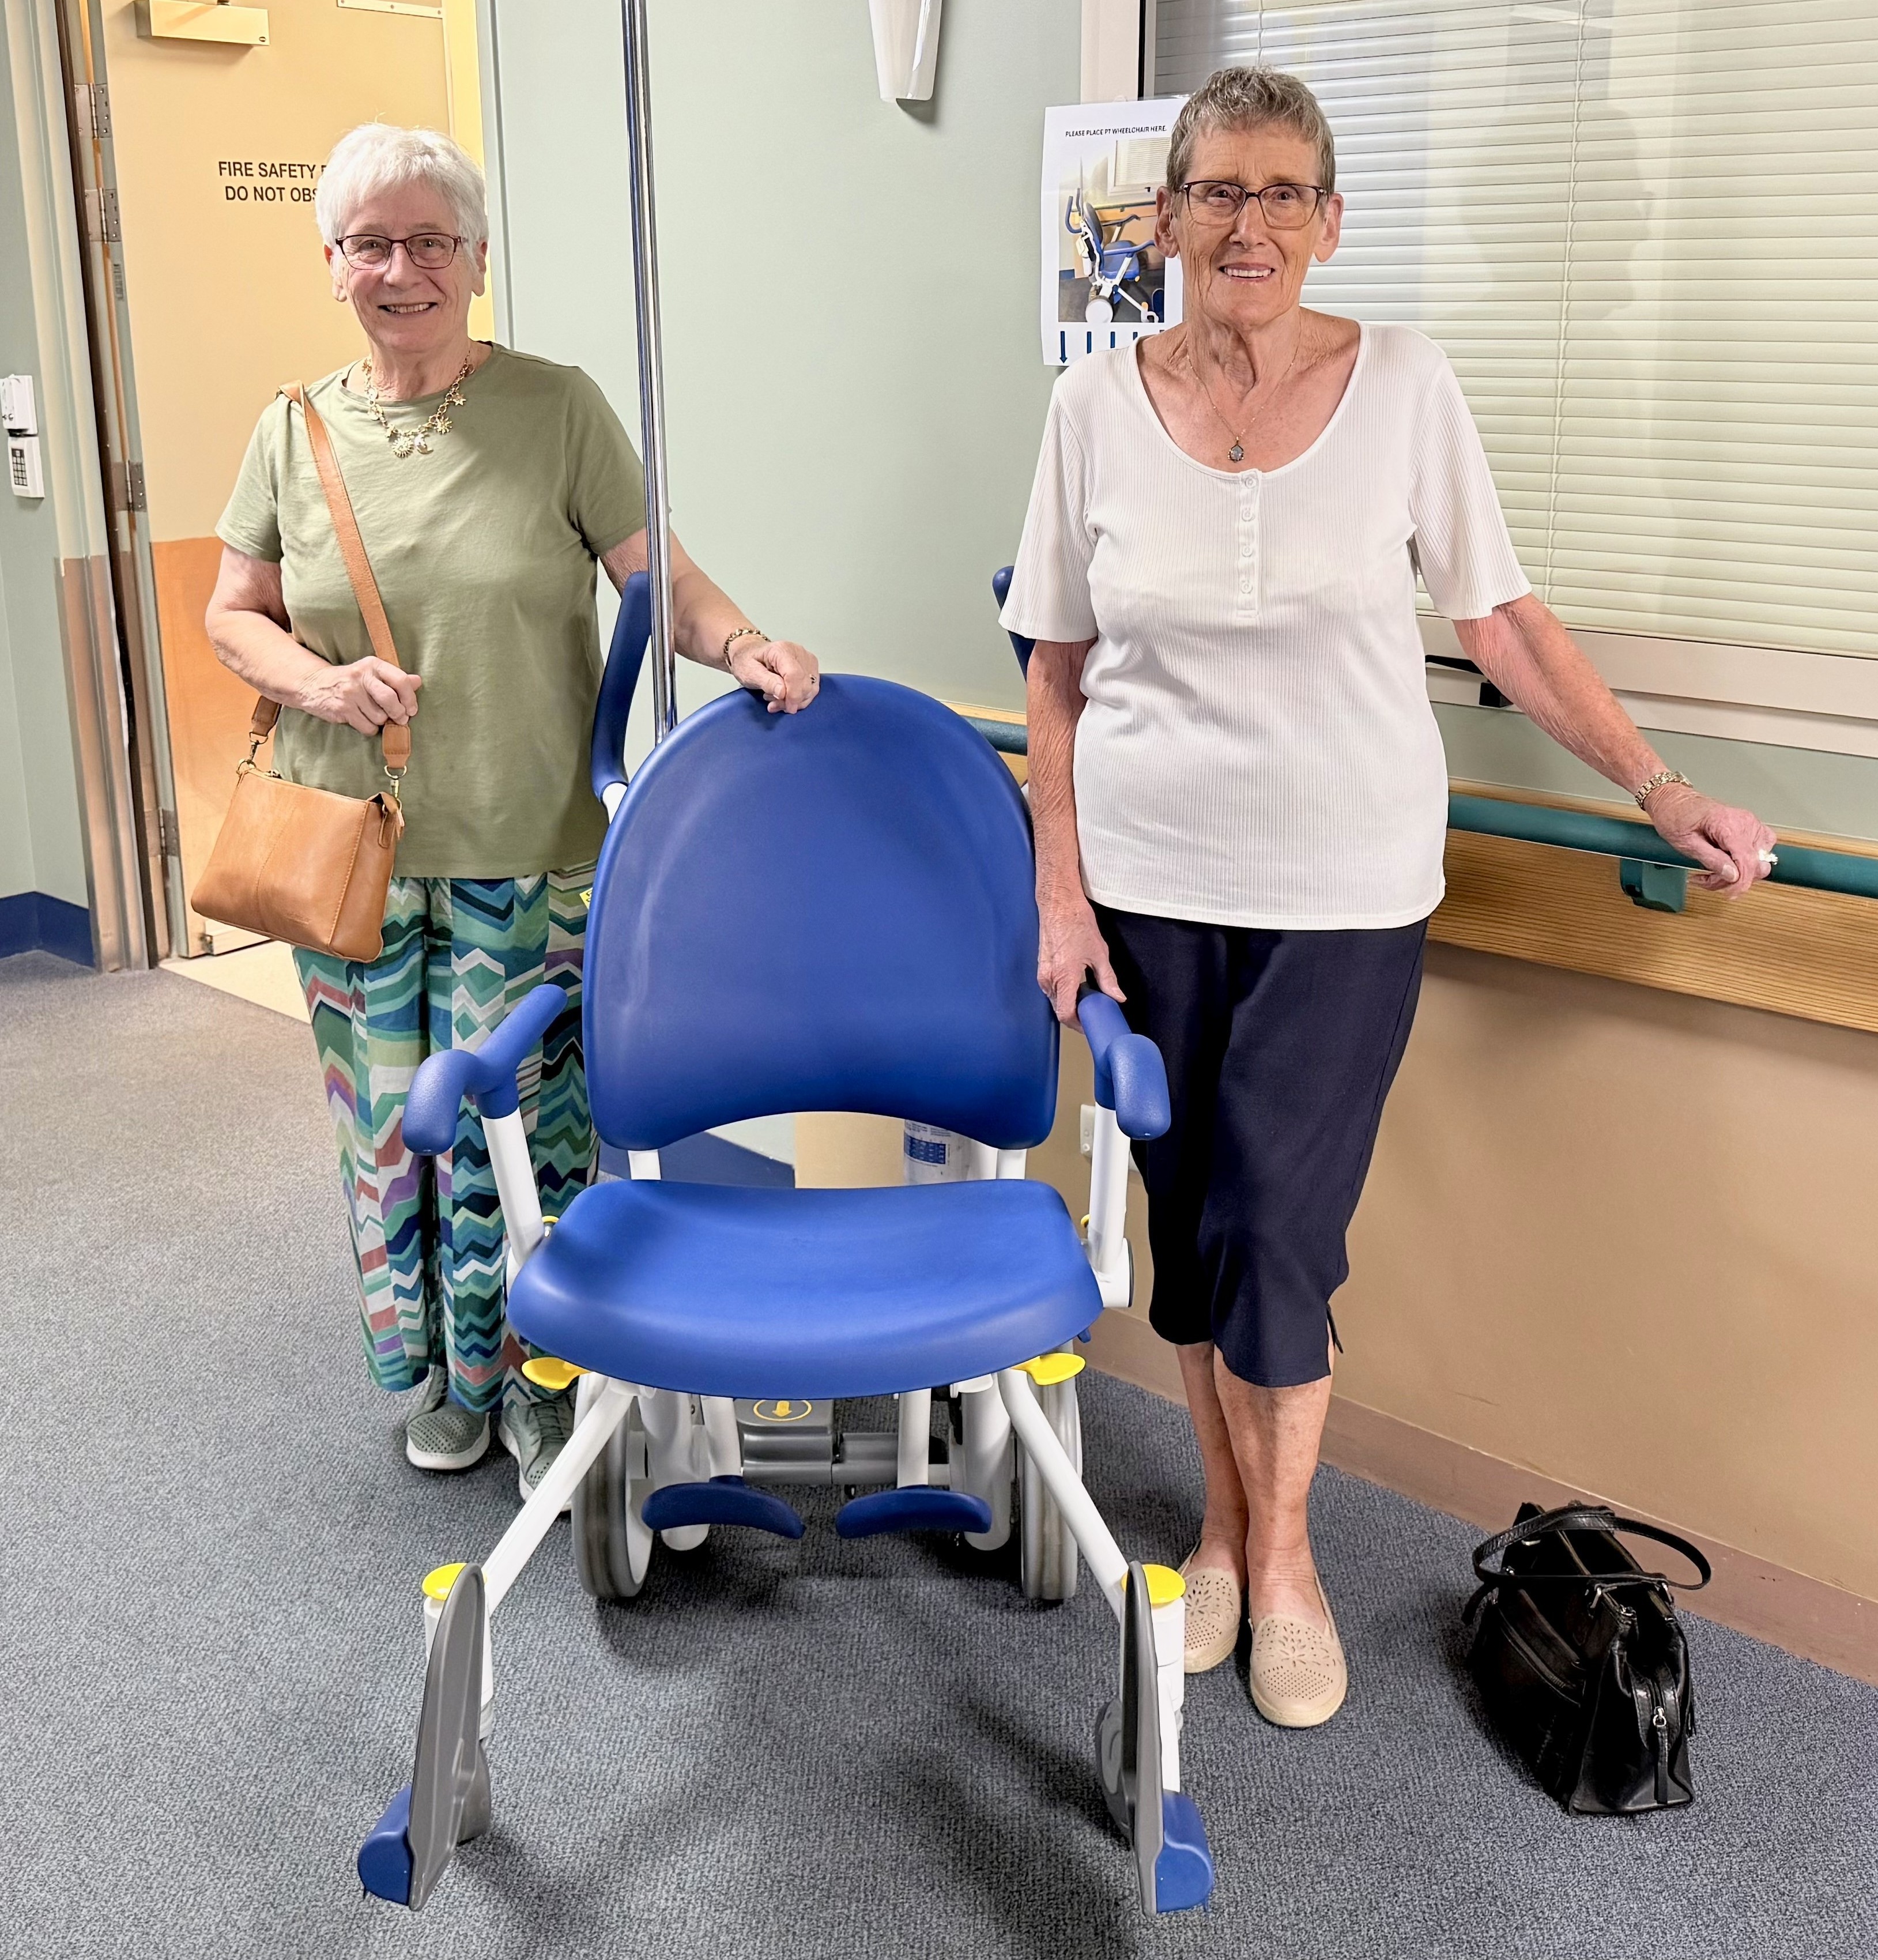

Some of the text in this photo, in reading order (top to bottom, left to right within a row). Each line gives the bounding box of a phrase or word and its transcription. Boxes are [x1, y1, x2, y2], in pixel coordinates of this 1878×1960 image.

[1113, 126, 1149, 134] WHEELCHAIR
[218, 161, 254, 177] FIRE
[258, 163, 316, 179] SAFETY
[225, 186, 248, 201] DO
[253, 186, 285, 202] NOT
